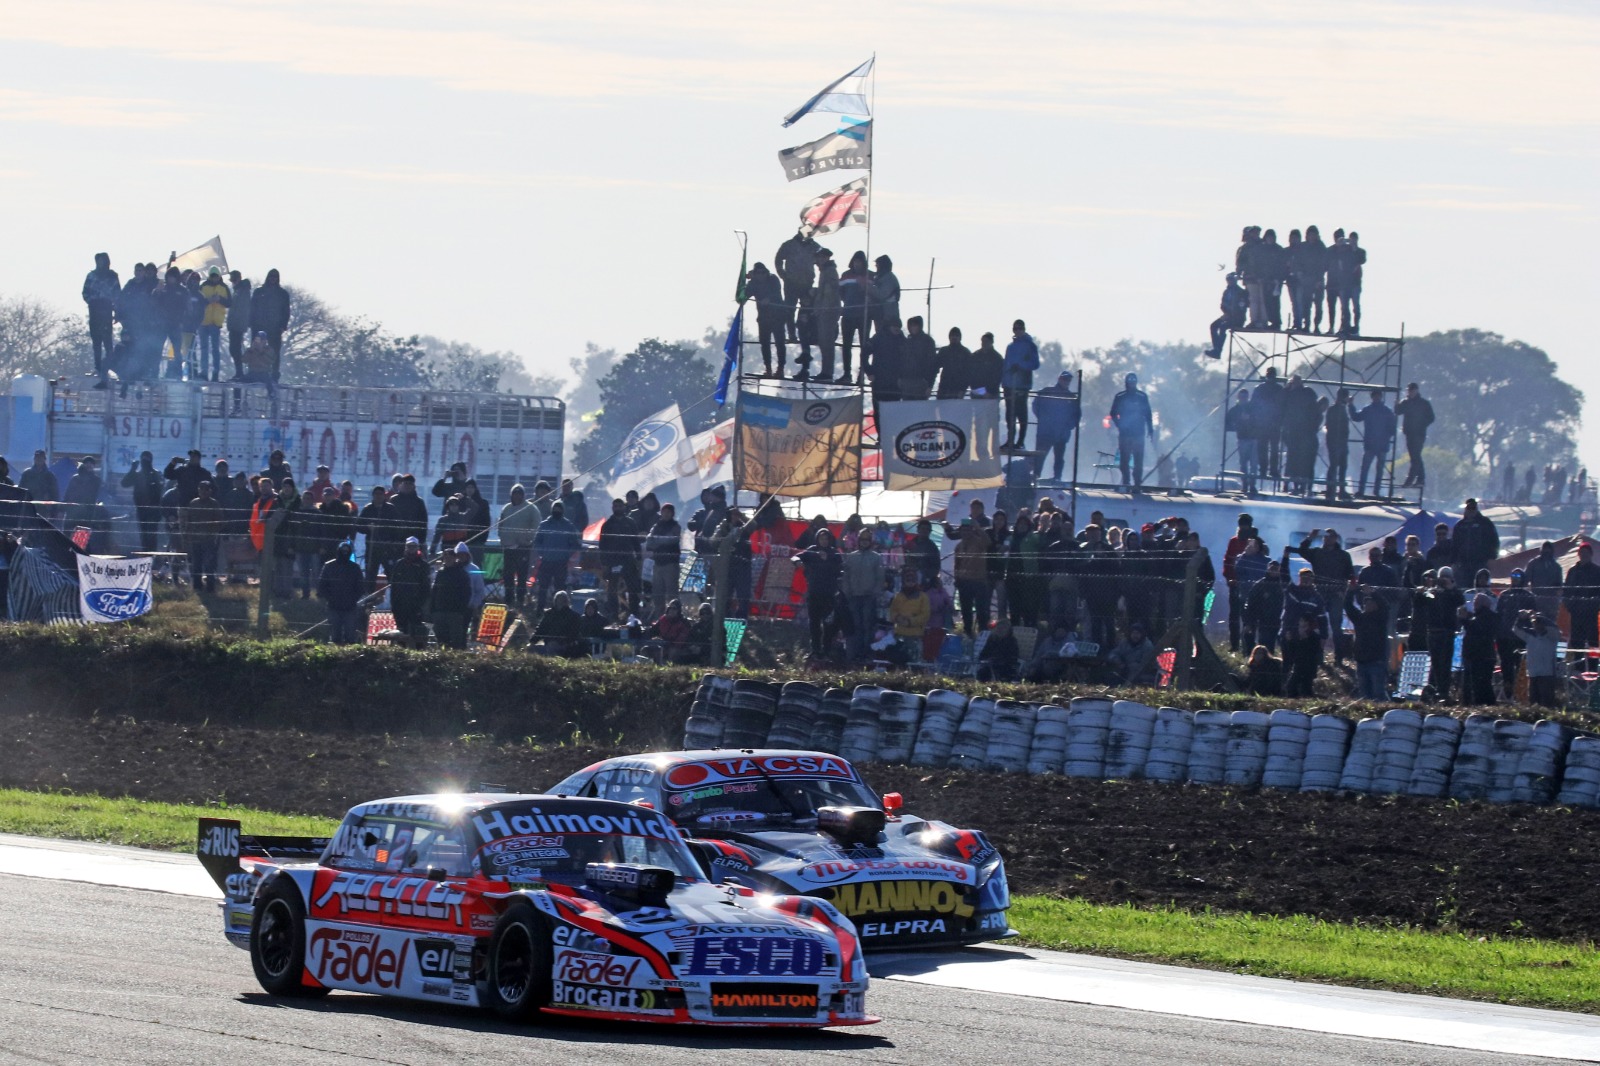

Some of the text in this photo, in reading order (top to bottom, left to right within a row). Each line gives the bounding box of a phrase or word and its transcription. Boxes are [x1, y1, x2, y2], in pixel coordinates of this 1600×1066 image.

[99, 592, 140, 615] Ford
[719, 757, 848, 776] TACSA
[473, 807, 683, 842] Haimovich
[522, 848, 566, 859] INTEGRA
[713, 857, 749, 872] ELPRA
[862, 919, 947, 937] ELPRA
[310, 927, 411, 990] Fadel
[557, 949, 641, 987] Fadel
[553, 980, 639, 1010] Brocart
[712, 994, 817, 1007] HAMILTON
